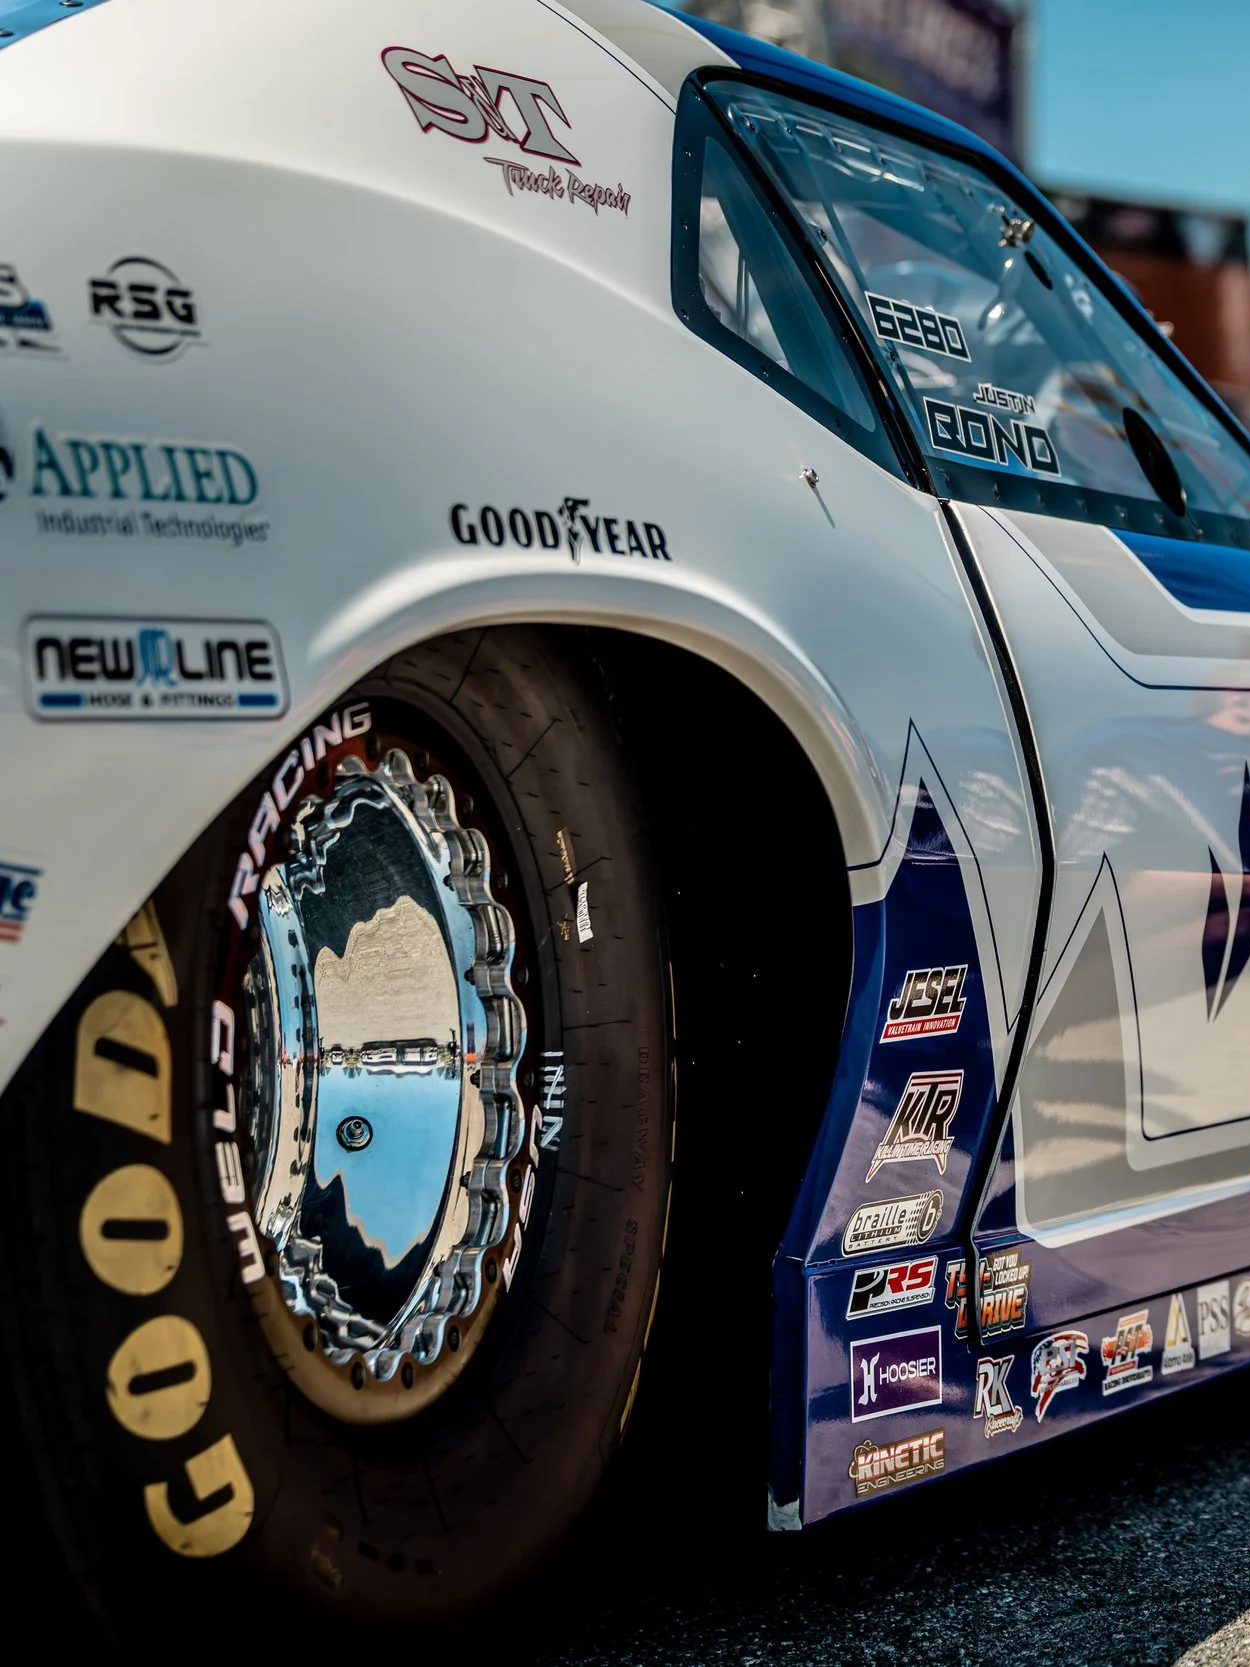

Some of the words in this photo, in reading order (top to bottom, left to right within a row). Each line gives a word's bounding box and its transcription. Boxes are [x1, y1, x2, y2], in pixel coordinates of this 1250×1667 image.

[484, 157, 566, 201] Truck
[564, 168, 632, 217] Repair
[89, 278, 198, 327] RSG
[865, 291, 971, 362] 6280
[973, 383, 1036, 416] JUSTIN
[923, 396, 1061, 478] BOND
[31, 425, 259, 507] APPLIED
[37, 511, 137, 537] Industrial
[88, 691, 133, 708] HOSE
[159, 691, 234, 709] FITTINGS
[227, 701, 373, 932] RACING
[888, 965, 968, 1021] JESEL
[887, 1022, 922, 1037] VALVETRAIN
[922, 1017, 957, 1032] INNOVATION
[884, 1079, 961, 1145] KTR
[210, 1000, 267, 1286] WELD
[848, 1235, 899, 1250] BATTERY
[850, 1225, 903, 1243] LITHIUM
[852, 1205, 907, 1233] braille
[994, 1267, 1019, 1286] LOCKED
[879, 1356, 936, 1386] HOOSIER
[976, 1358, 1014, 1416] RK
[857, 1431, 944, 1481] KINETIC
[857, 1458, 945, 1494] ENGINEERING
